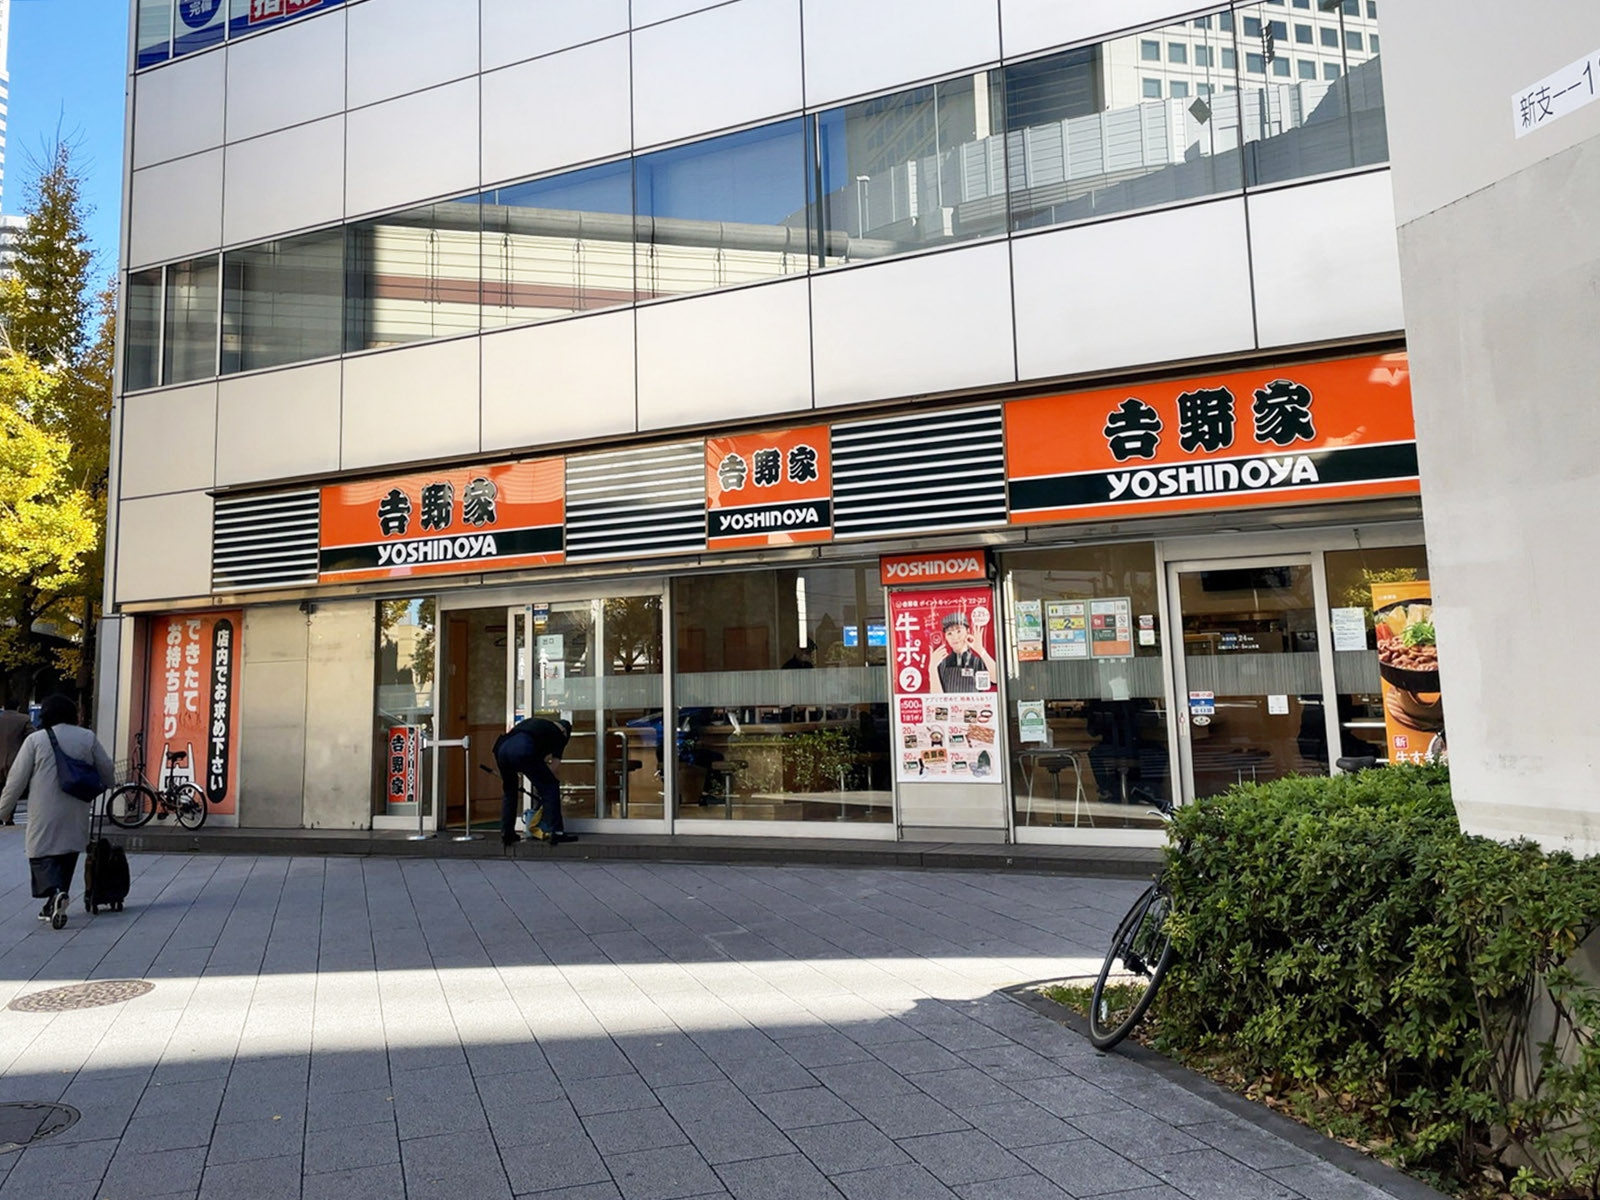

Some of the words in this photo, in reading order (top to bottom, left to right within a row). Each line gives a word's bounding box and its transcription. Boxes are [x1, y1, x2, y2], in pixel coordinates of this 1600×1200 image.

[1103, 378, 1317, 462] 吉野家
[717, 444, 819, 492] 吉野家
[1107, 455, 1320, 500] YOSHINOYA
[377, 476, 498, 537] 吉野家
[720, 507, 819, 531] YOSHINOYA
[377, 534, 498, 565] YOSHINOYA
[886, 558, 979, 577] YOSHINOYA
[163, 624, 182, 739] お持ち帰り
[183, 619, 200, 712] できたて
[211, 629, 230, 791] 店内でお求め下さい
[391, 734, 406, 796] 吉野家
